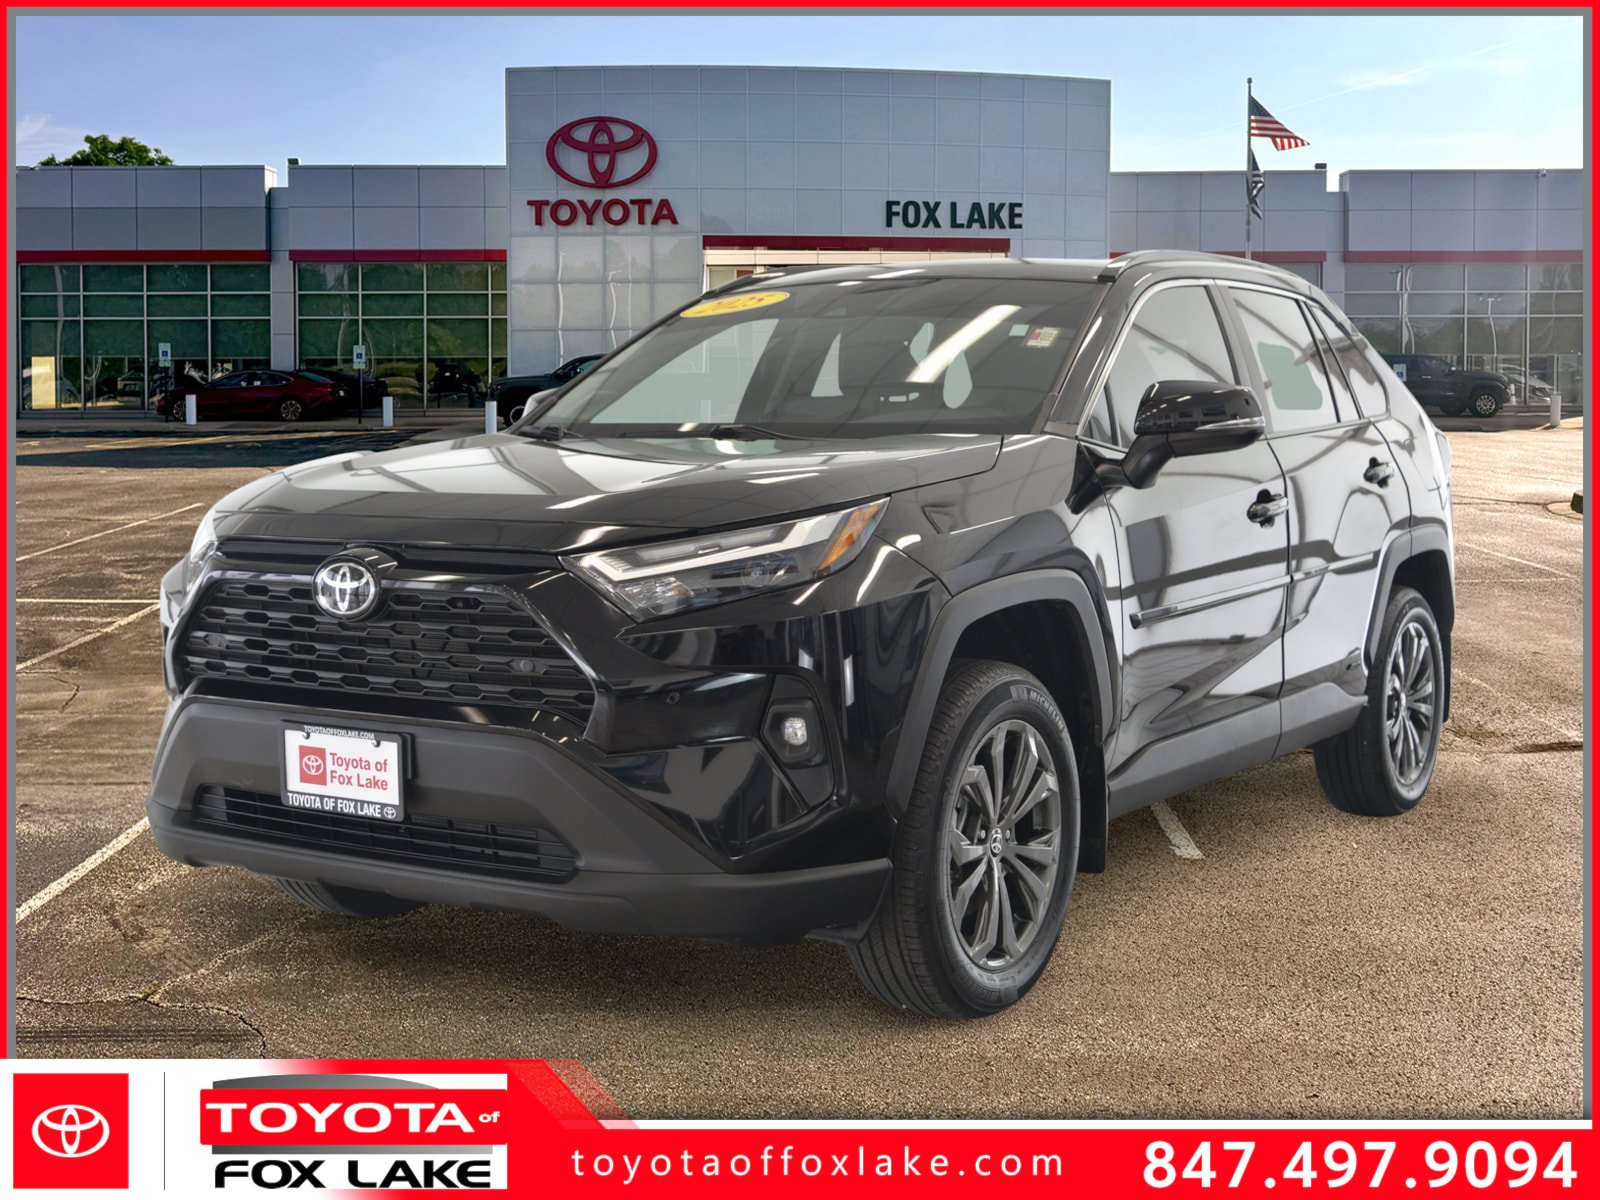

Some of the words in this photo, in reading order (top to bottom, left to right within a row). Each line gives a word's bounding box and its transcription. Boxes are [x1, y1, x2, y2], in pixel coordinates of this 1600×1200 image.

[527, 198, 679, 226] TOYOTA
[885, 200, 942, 229] FOX
[950, 201, 1023, 230] LAKE
[303, 725, 375, 740] TOYOTAOFFOXLAKE.COM
[329, 752, 371, 771] Toyota
[375, 759, 388, 773] of
[330, 770, 353, 787] Fox
[357, 773, 388, 791] Lake
[287, 792, 321, 809] TOYOTA
[323, 797, 336, 811] OF
[337, 799, 356, 814] FOX
[357, 802, 382, 817] LAKE
